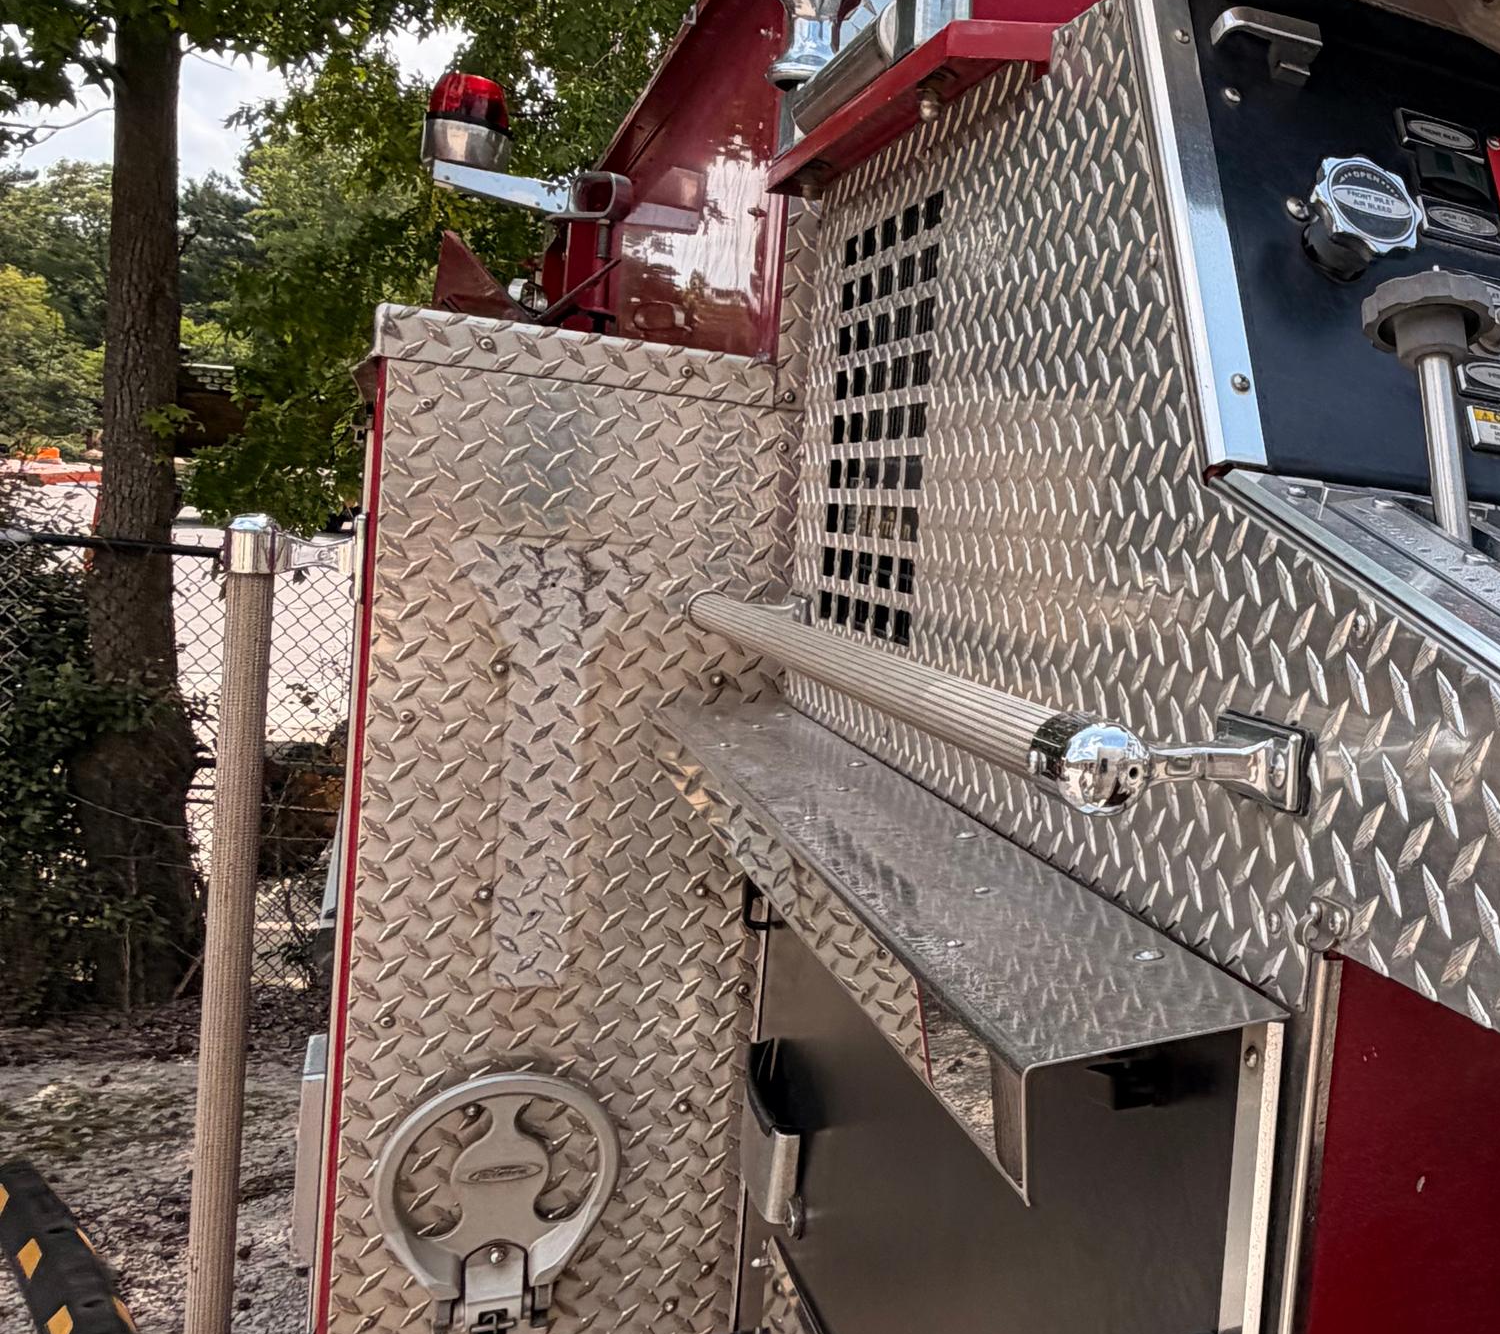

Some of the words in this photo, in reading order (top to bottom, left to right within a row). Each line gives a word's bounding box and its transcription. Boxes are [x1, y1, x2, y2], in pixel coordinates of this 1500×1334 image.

[1354, 169, 1380, 184] OPEN
[1346, 190, 1372, 203] FRONT
[1373, 195, 1395, 206] INLET
[1353, 200, 1366, 210] AIR
[1367, 203, 1392, 214] BLEED
